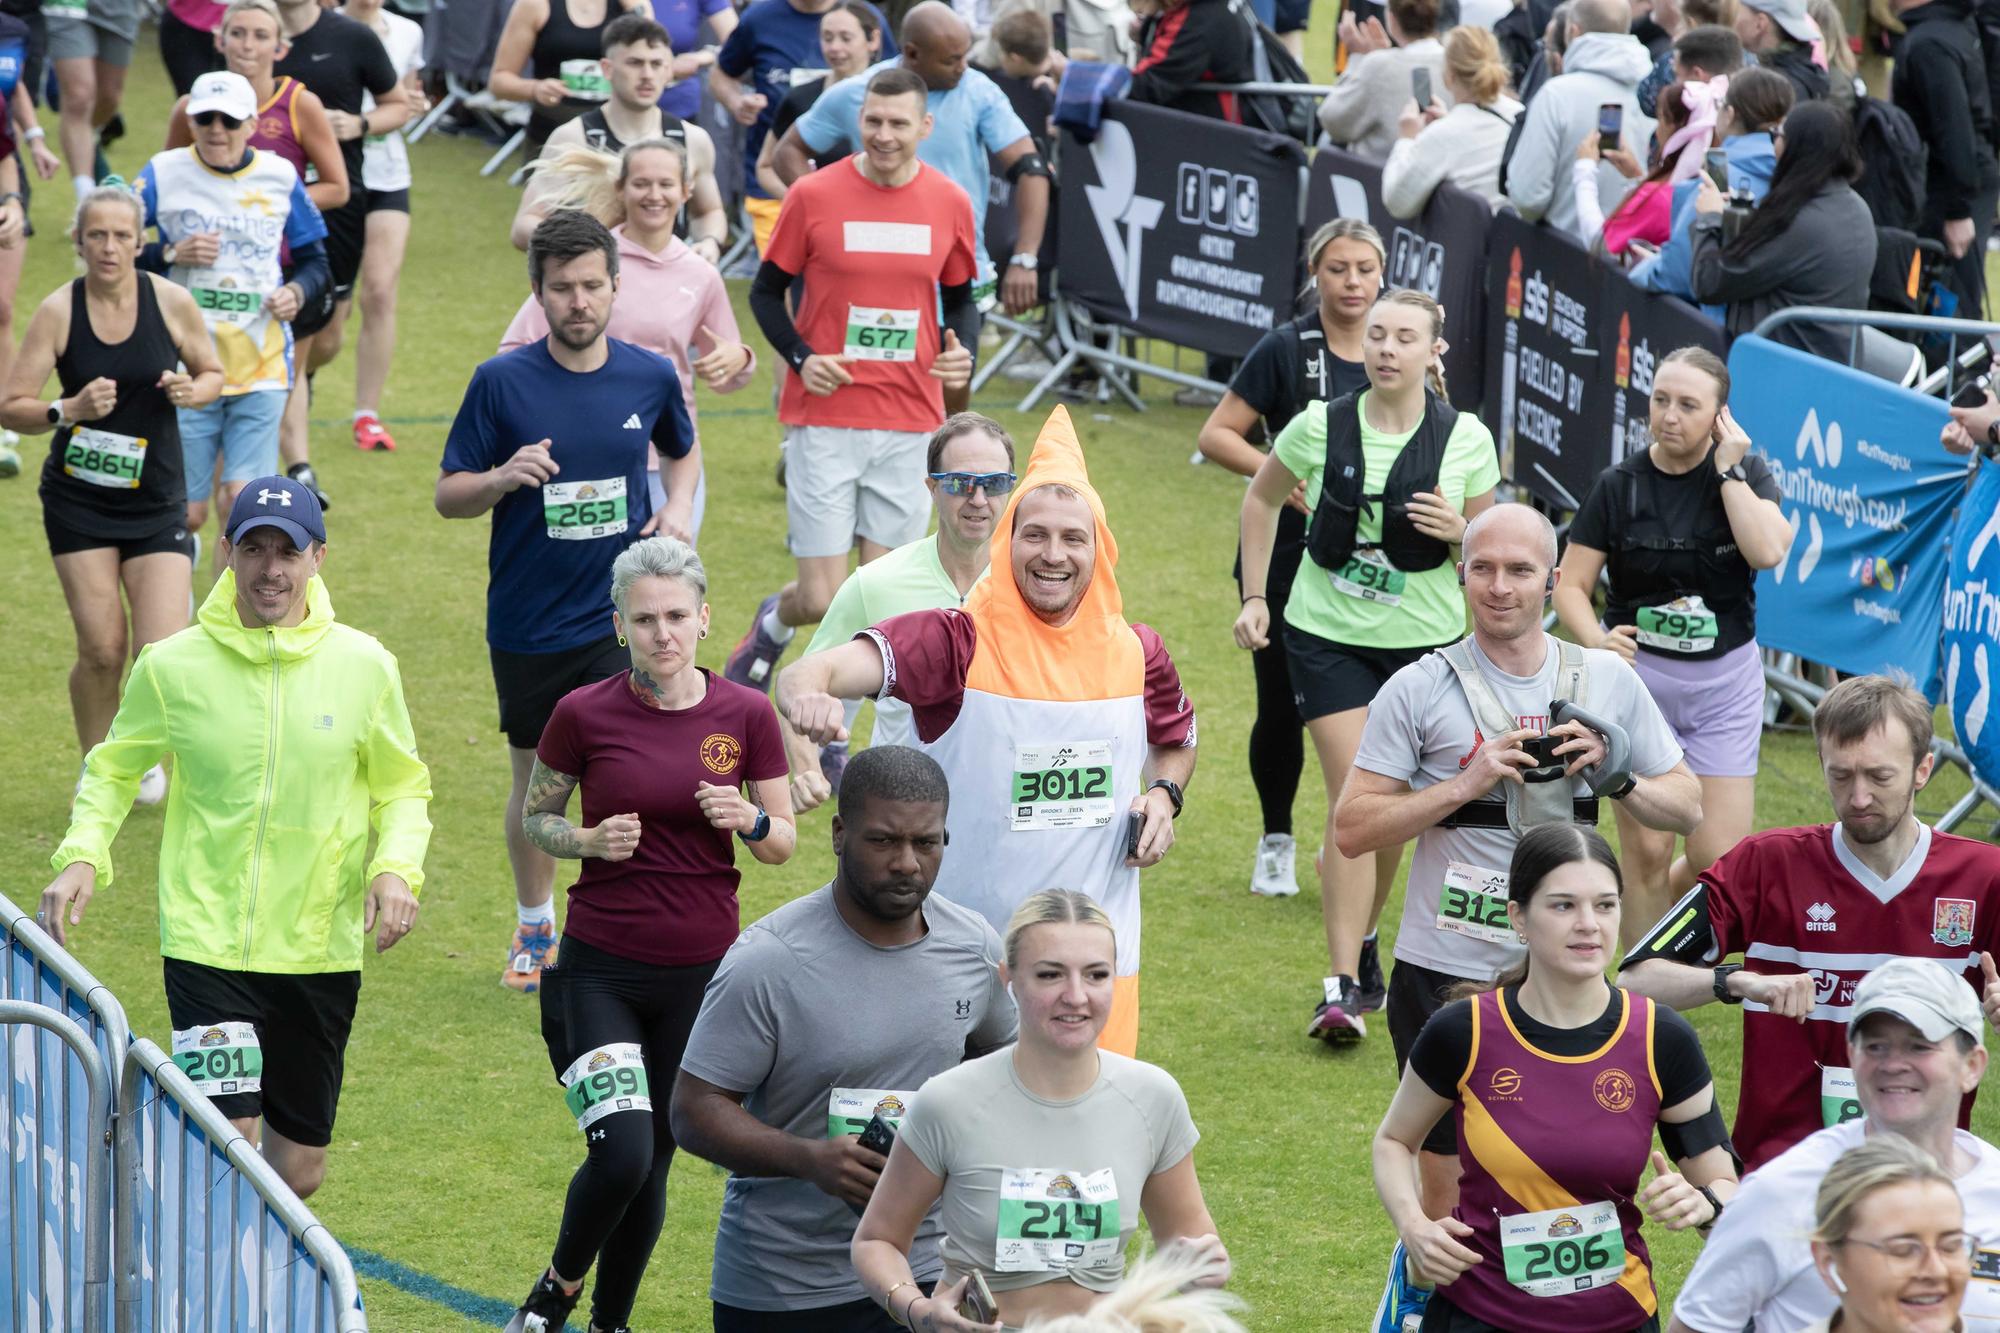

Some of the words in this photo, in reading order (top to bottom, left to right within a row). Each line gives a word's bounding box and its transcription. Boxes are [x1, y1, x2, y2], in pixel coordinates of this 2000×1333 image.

[201, 289, 251, 312] 329
[1552, 290, 1587, 327] SCIENCE
[858, 326, 908, 349] 677
[1519, 346, 1567, 403] FUELLED
[1567, 372, 1584, 415] BY
[1517, 398, 1563, 457] SCIENCE
[67, 444, 139, 480] 2864
[557, 500, 616, 527] 263
[1344, 557, 1390, 593] 791
[1649, 610, 1706, 639] 792
[1018, 767, 1107, 802] 3012
[1443, 886, 1514, 929] 312
[1805, 921, 1837, 932] errea
[184, 1047, 249, 1081] 201
[576, 1067, 639, 1111] 199
[838, 1098, 863, 1107] BROOKS
[1487, 1095, 1524, 1103] SCIMITAR
[1019, 1201, 1102, 1240] 214
[1510, 1225, 1537, 1234] BROOKS
[1524, 1233, 1610, 1281] 206
